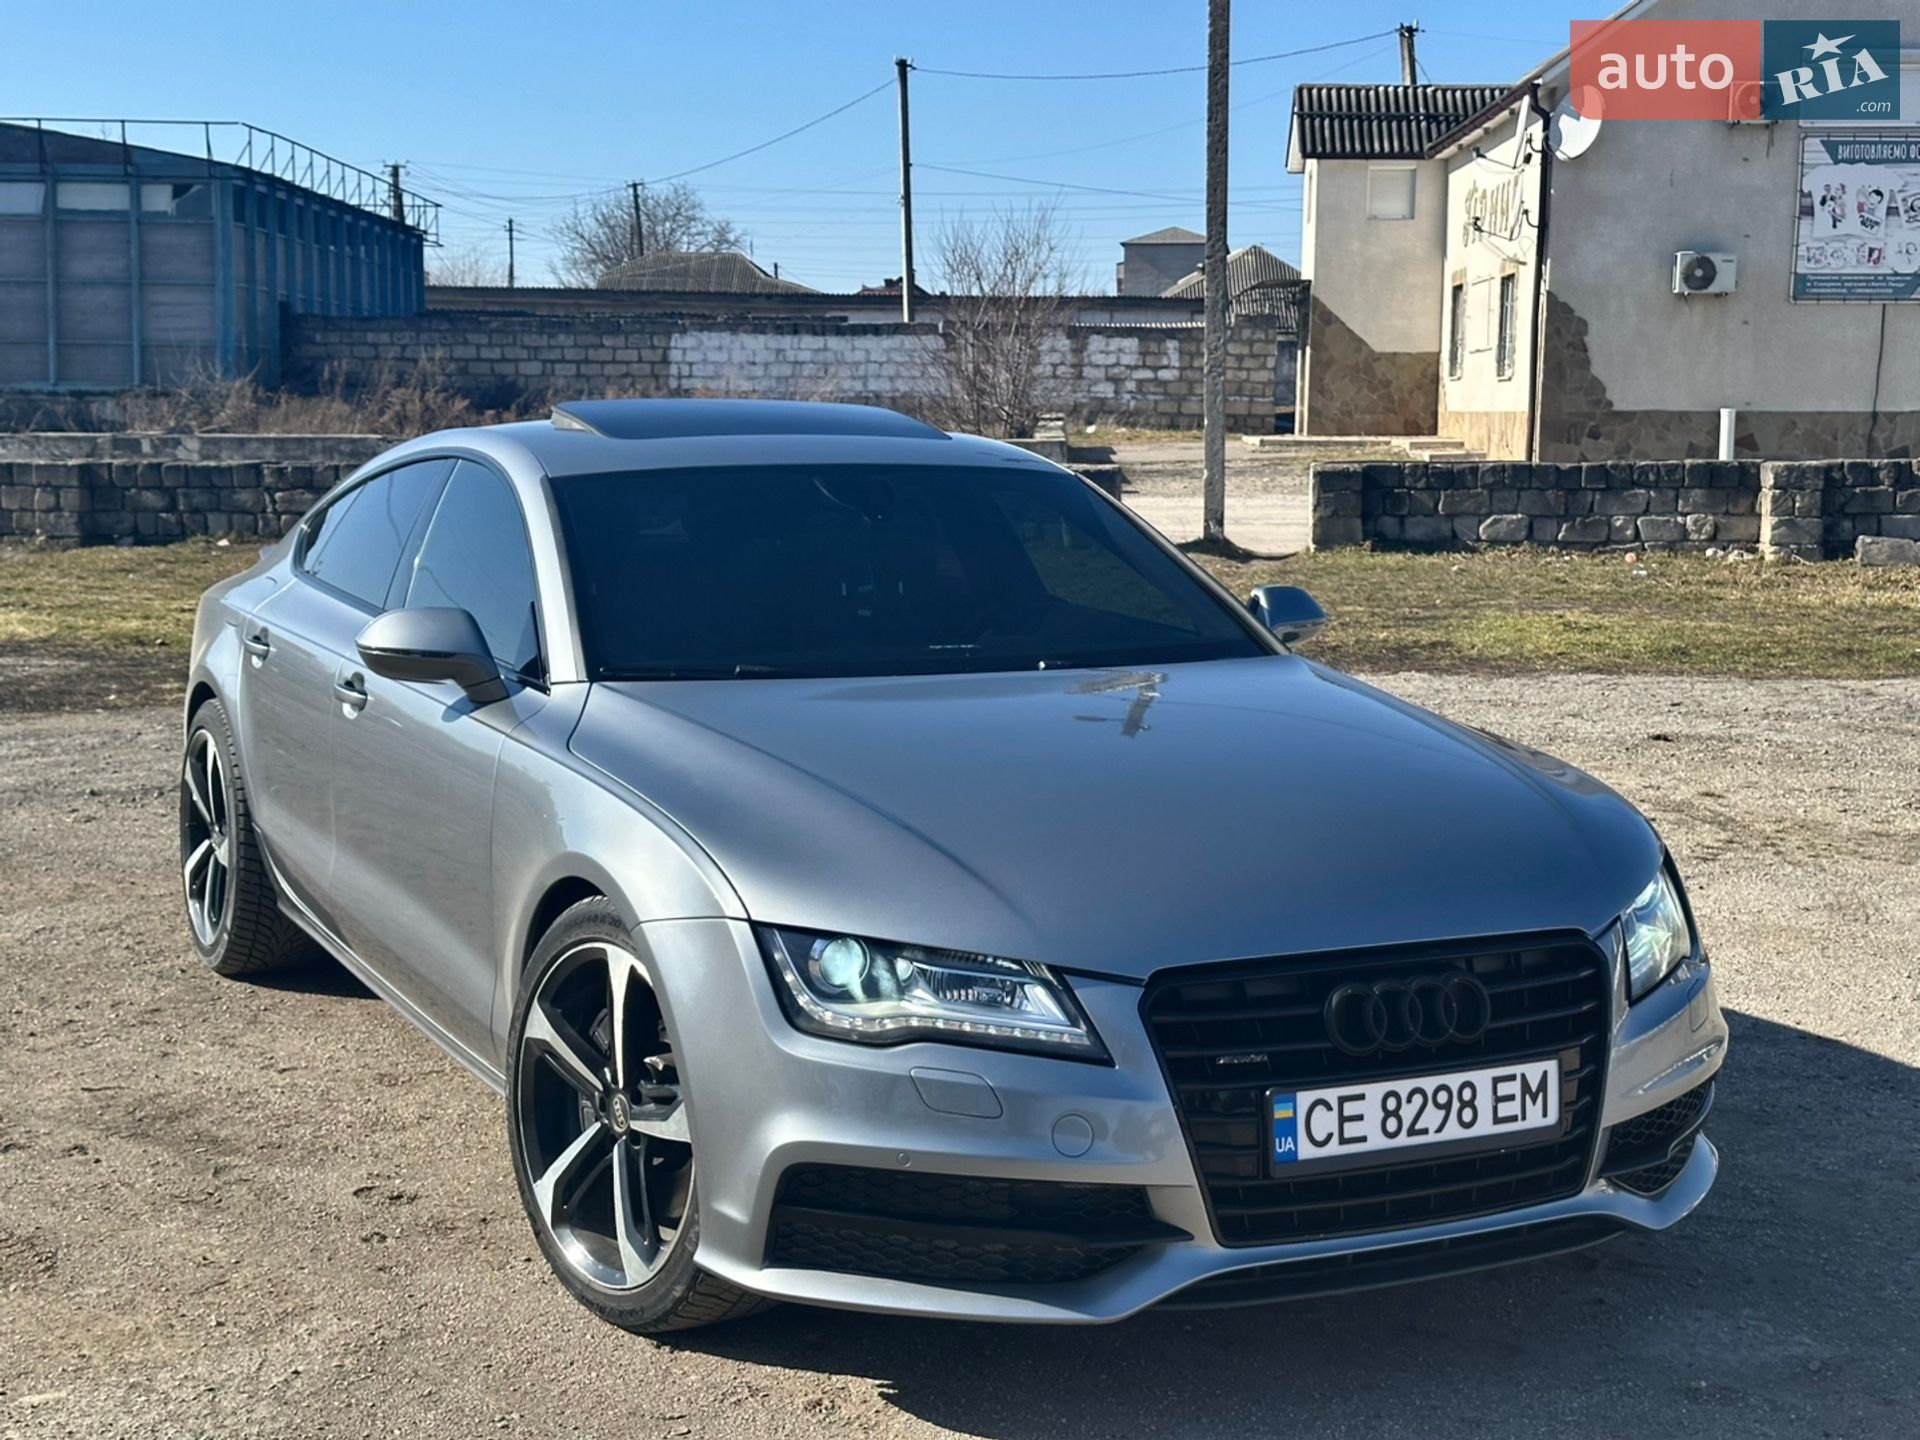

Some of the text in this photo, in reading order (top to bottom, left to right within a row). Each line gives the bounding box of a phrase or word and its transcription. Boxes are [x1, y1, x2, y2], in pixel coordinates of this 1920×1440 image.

[1838, 144, 1907, 160] ВИГОТОВЛЯЄМО
[1305, 1069, 1548, 1148] CE 8298 EM
[1275, 1136, 1295, 1153] UA
